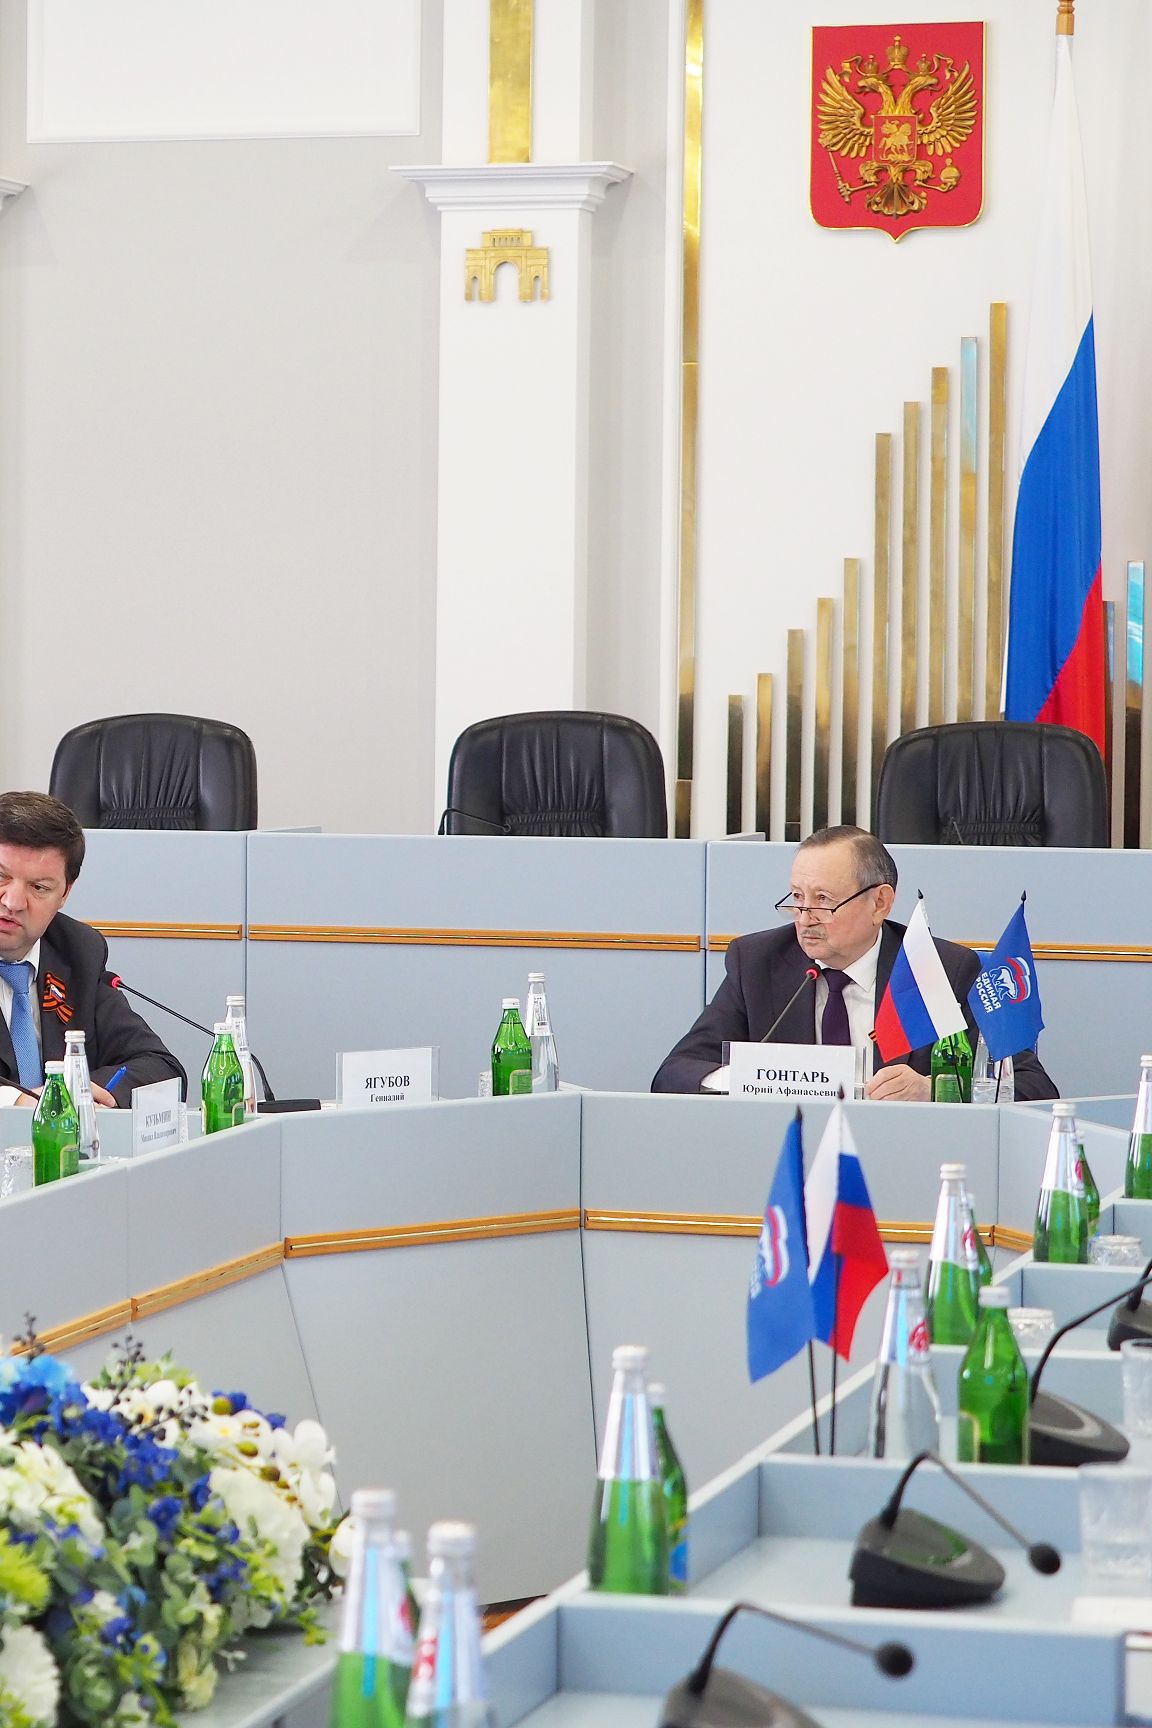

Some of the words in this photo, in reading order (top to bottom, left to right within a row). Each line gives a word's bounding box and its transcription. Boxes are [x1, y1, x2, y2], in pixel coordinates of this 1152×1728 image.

[975, 976, 993, 1014] РОССИЯ
[981, 971, 1002, 1010] ЕДИНАЯ
[364, 1075, 410, 1089] ЯГУБОВ
[756, 1068, 830, 1083] ГОНТАРЬ
[370, 1093, 405, 1102] Геннадий
[742, 1084, 773, 1096] Юрий
[775, 1086, 844, 1097] Афанасьеви
